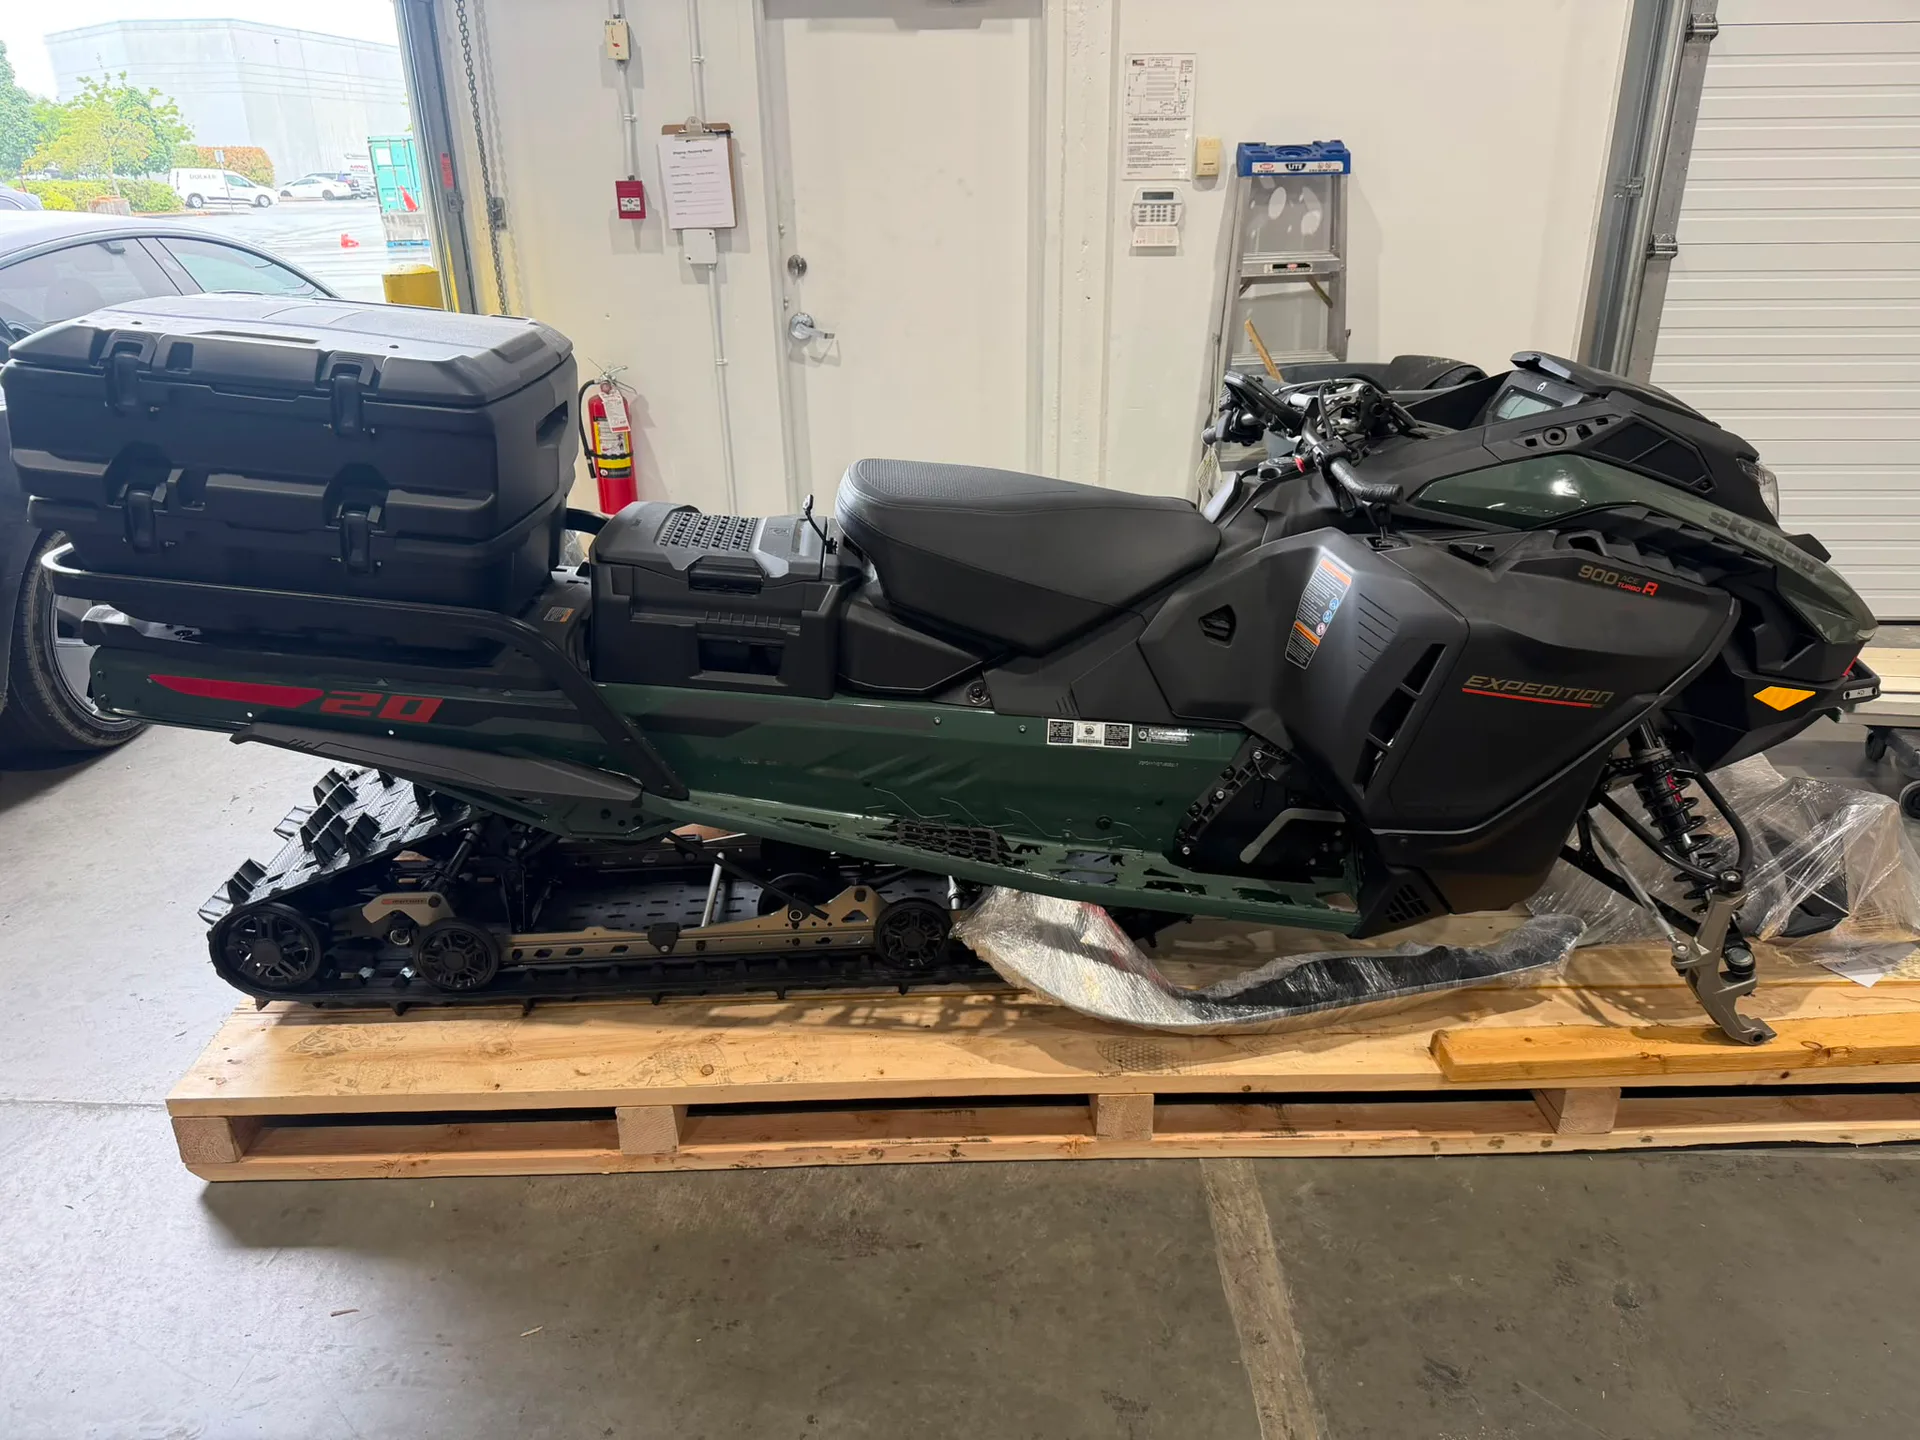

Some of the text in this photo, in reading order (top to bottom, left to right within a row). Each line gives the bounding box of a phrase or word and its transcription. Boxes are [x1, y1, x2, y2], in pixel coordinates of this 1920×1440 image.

[1578, 565, 1641, 585] 900 ACE
[1617, 581, 1660, 596] TURBO R
[1463, 675, 1615, 703] EXPEDITION
[319, 690, 444, 723] 20
